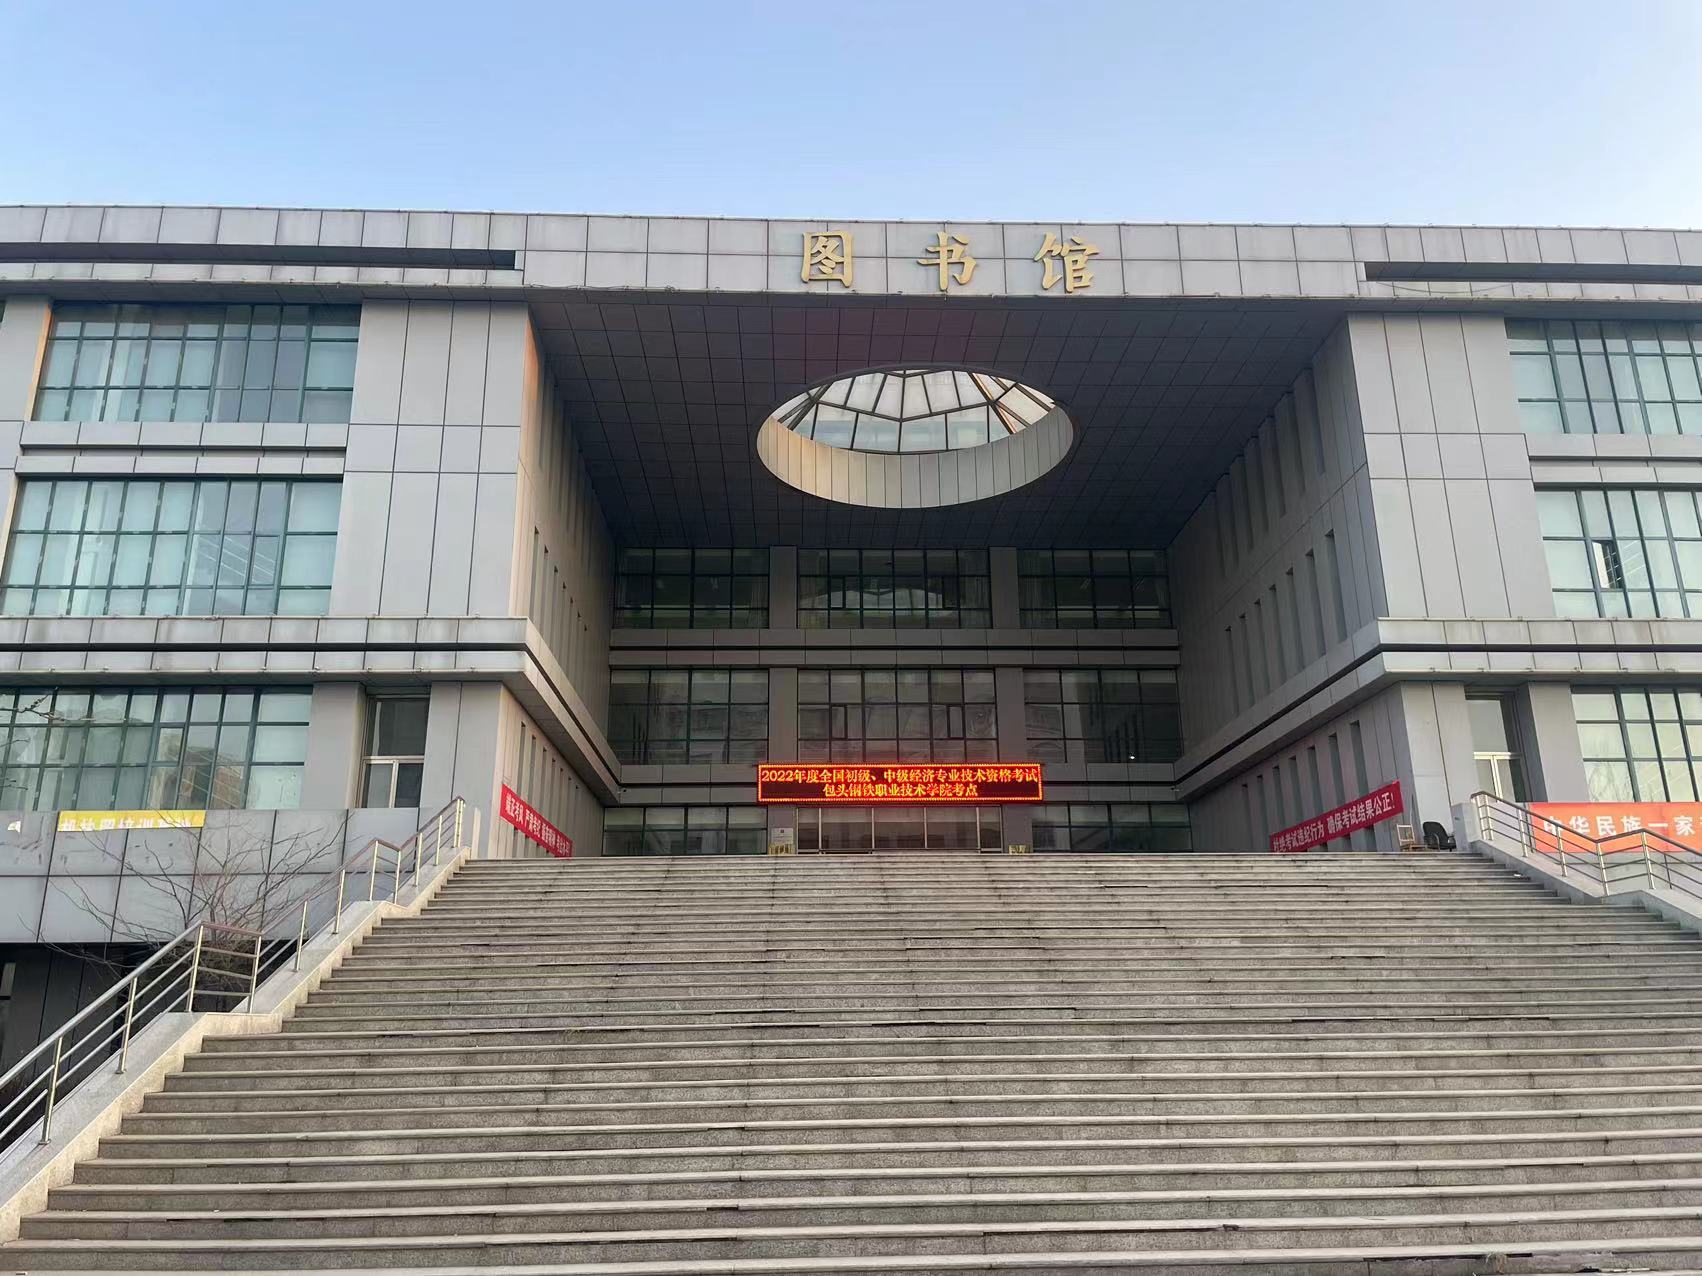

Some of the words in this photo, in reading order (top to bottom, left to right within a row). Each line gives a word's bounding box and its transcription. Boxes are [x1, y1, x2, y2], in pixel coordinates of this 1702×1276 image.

[801, 230, 1099, 293] 图书馆
[761, 768, 1038, 783] 2022年度全国初级、中级经济专业技术资格考试
[823, 783, 978, 798] 包头钢铁职业技术学院考点
[1543, 815, 1702, 837] 中华民族一家
